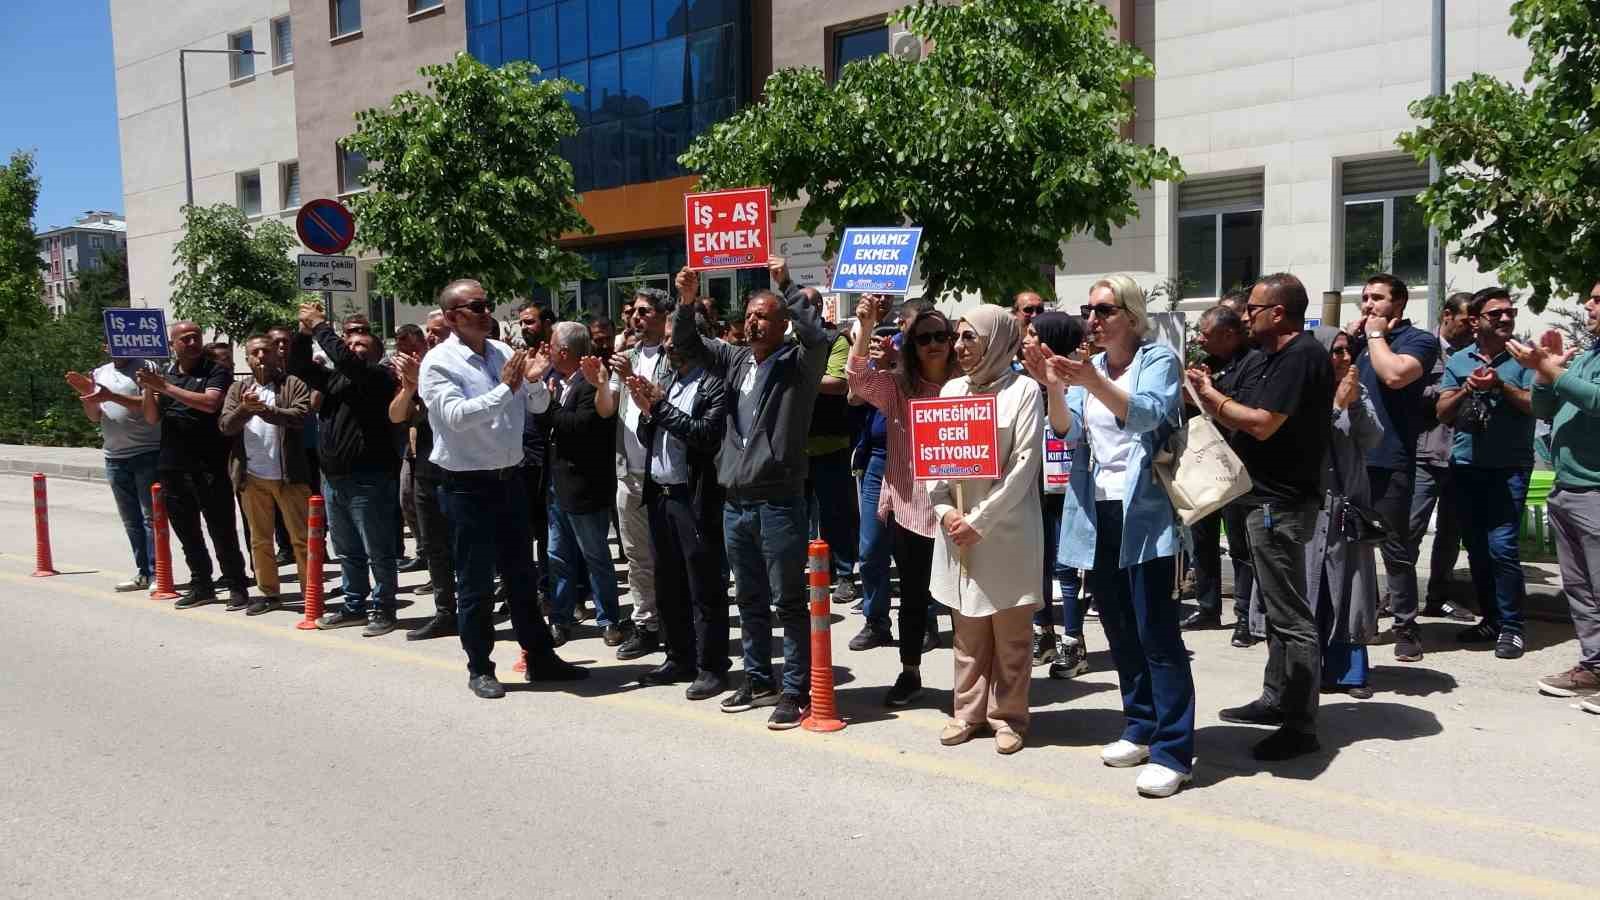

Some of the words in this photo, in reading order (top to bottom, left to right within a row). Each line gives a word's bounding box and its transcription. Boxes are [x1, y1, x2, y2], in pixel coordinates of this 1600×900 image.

[694, 200, 713, 229] İŞ
[732, 201, 759, 226] AŞ
[693, 229, 761, 252] EKMEK
[852, 233, 911, 246] DAVAMIZ
[854, 248, 900, 261] EKMEK
[331, 260, 353, 270] Çekilir
[840, 263, 908, 276] DAVASIDIR
[110, 313, 125, 332] İŞ
[139, 317, 158, 332] AŞ
[112, 334, 163, 347] EKMEK
[915, 402, 991, 424] EKMEĞİMİZİ
[938, 422, 969, 441] GERİ
[920, 443, 990, 461] İSTİYORUZ
